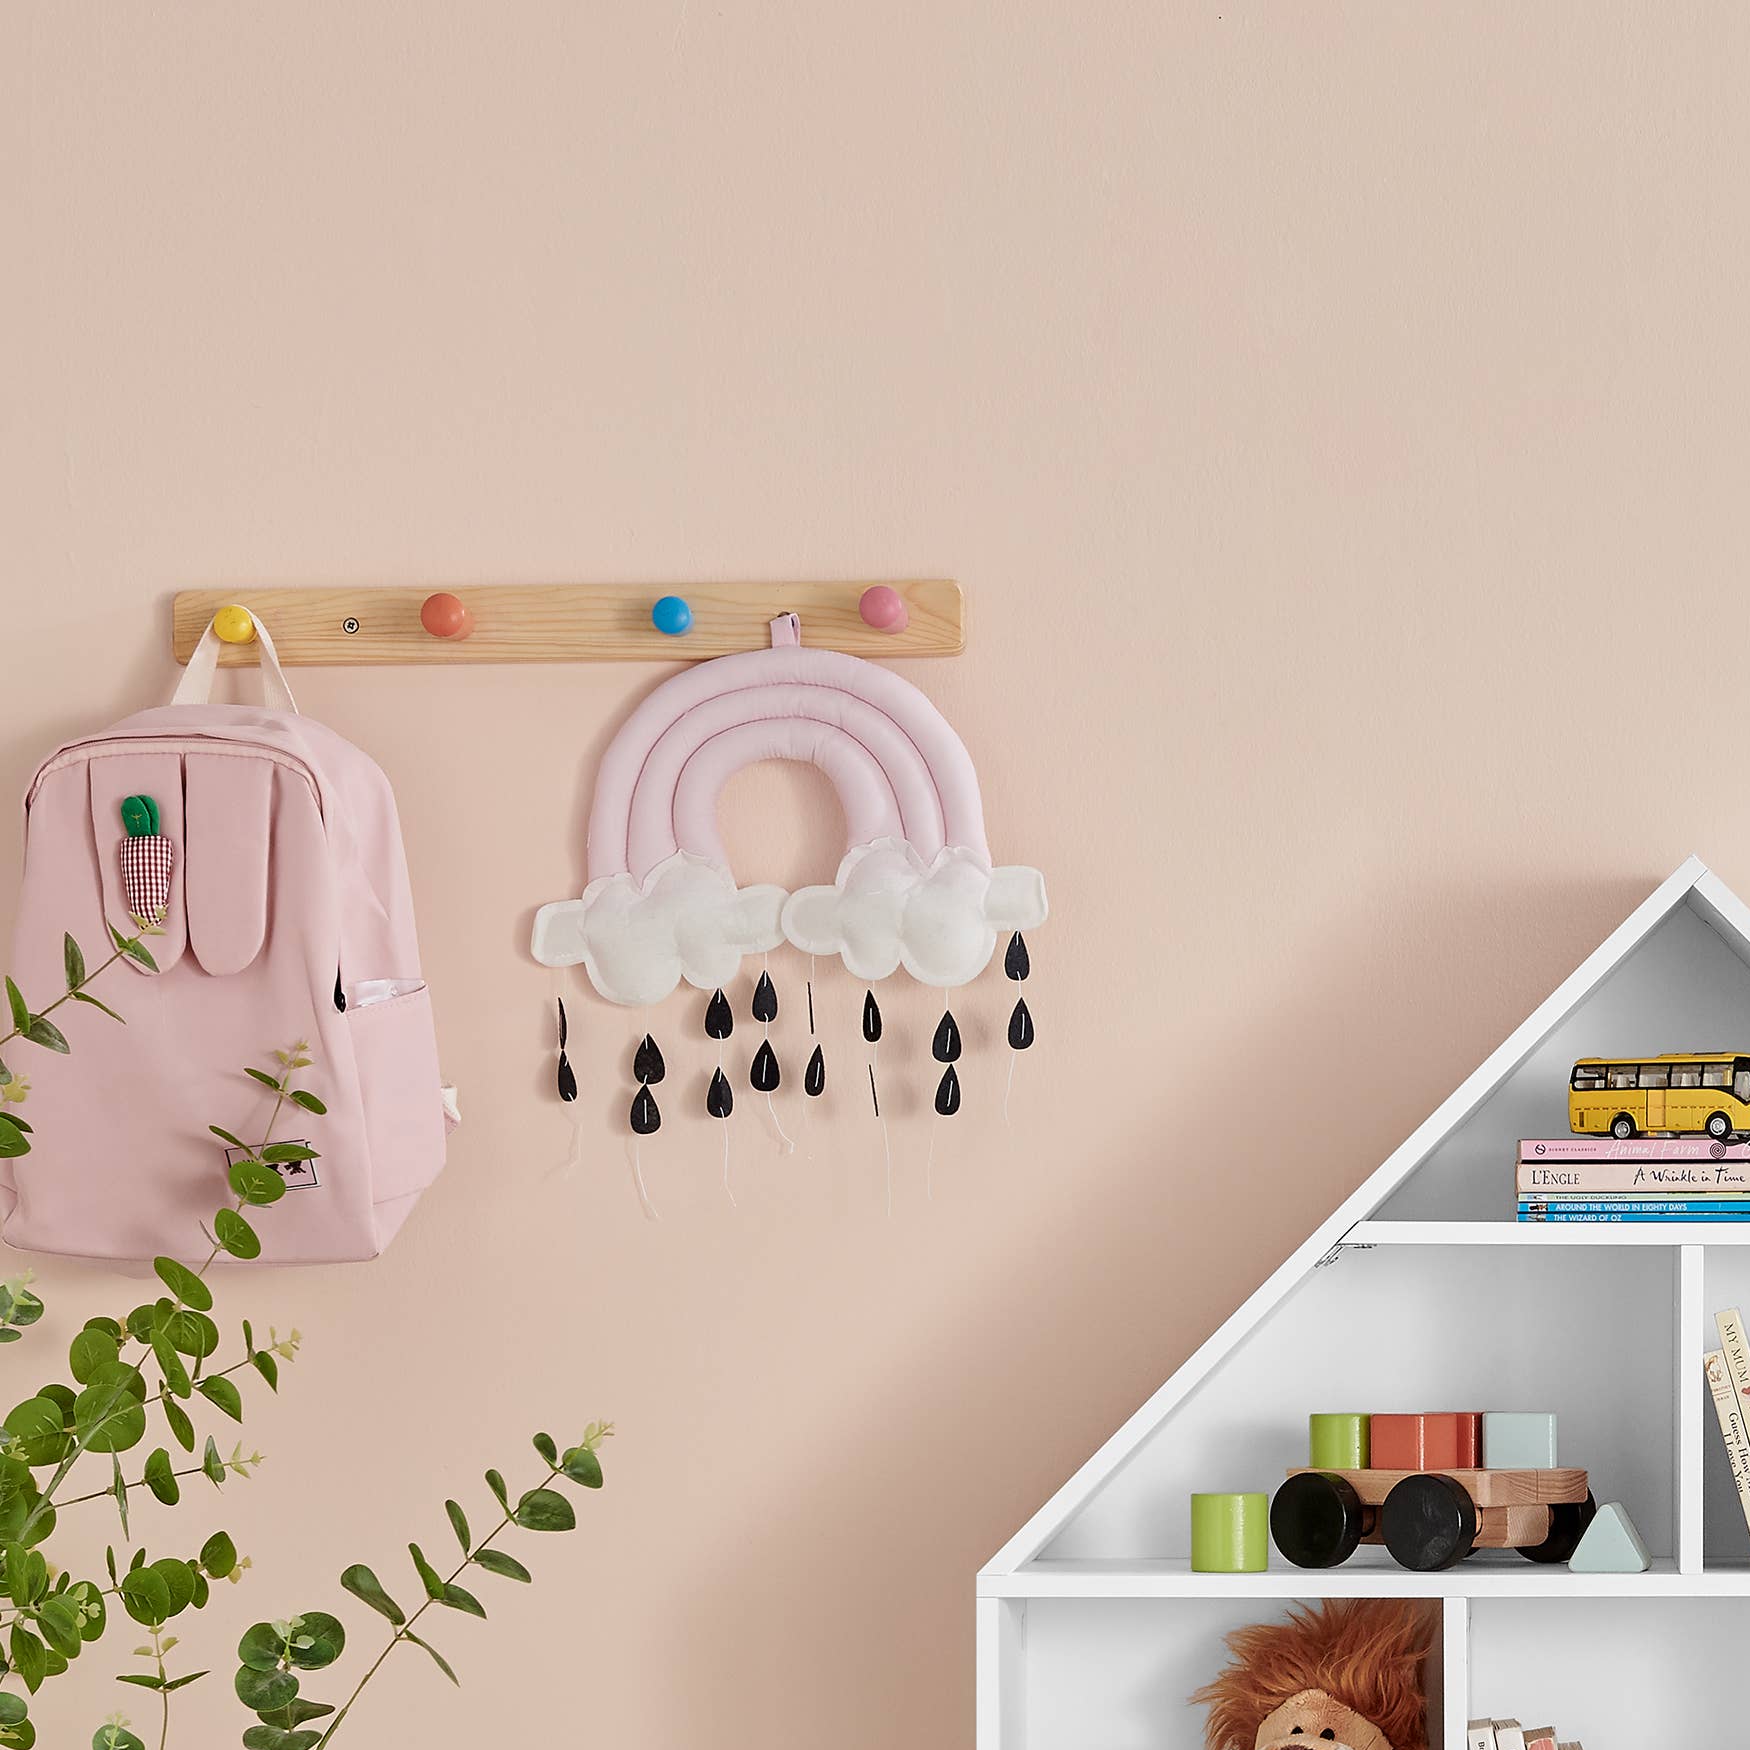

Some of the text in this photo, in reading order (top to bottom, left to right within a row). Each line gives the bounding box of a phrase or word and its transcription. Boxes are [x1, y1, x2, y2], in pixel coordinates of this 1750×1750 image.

[1605, 1140, 1700, 1159] Animal Farm
[1633, 1166, 1746, 1185] A Wrinkle in Time
[1555, 1203, 1687, 1211] AROUND THE WORLD IN EIGHTY DAYS
[1724, 1323, 1749, 1382] MY MUM
[1728, 1412, 1740, 1446] Guess
[1738, 1448, 1750, 1474] How
